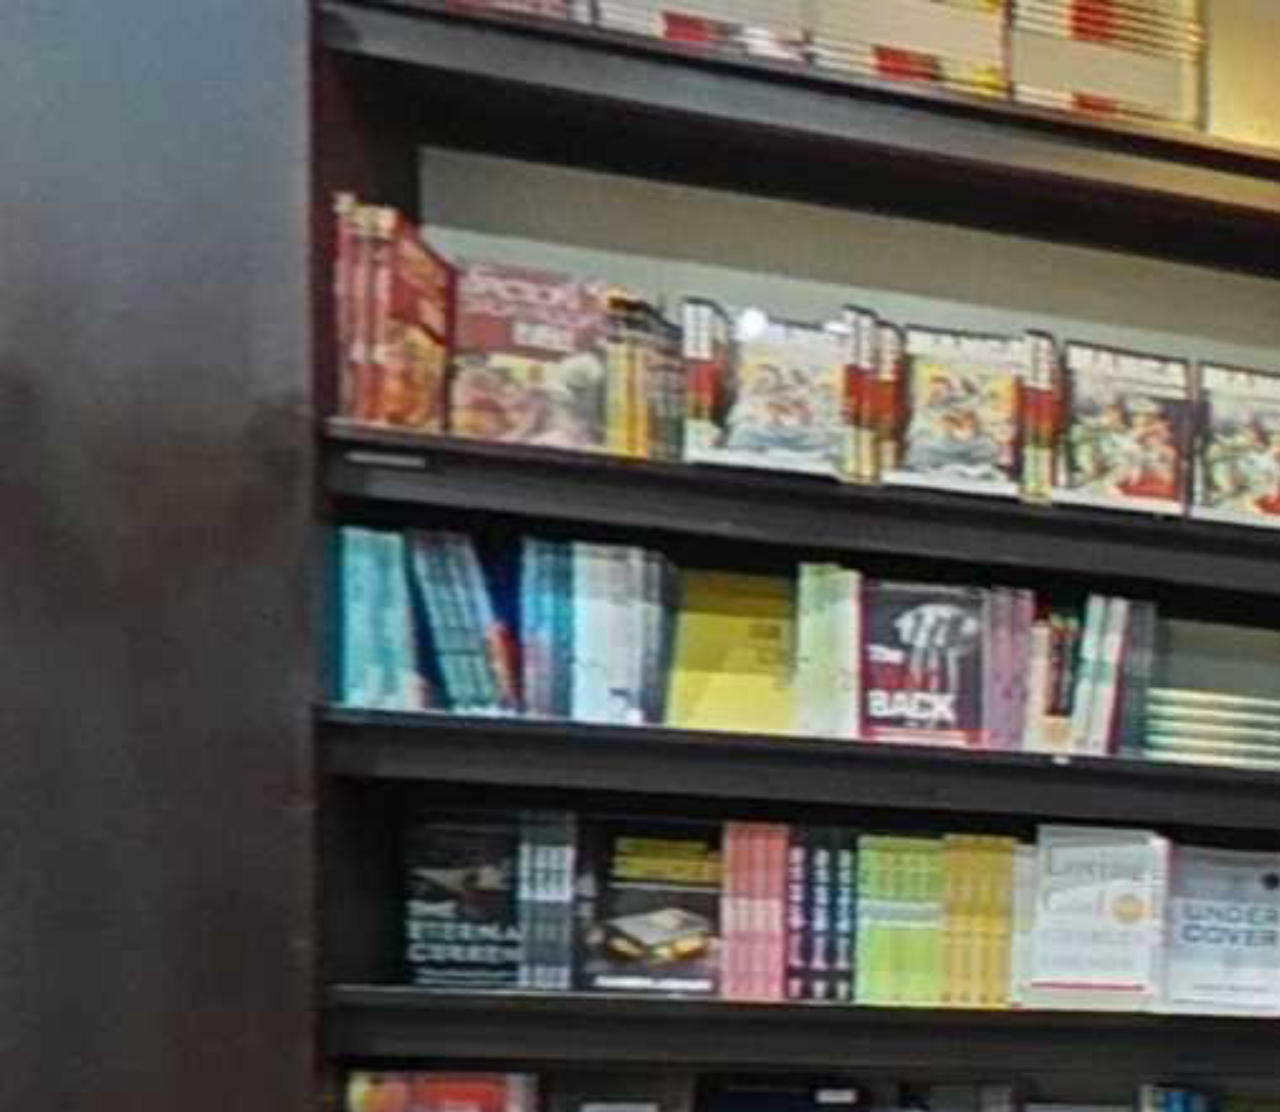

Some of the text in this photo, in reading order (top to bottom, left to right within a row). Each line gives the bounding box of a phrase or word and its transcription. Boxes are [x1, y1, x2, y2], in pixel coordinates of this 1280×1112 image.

[867, 690, 957, 721] BACK
[1183, 899, 1277, 924] UNDER
[1182, 924, 1277, 946] COVER
